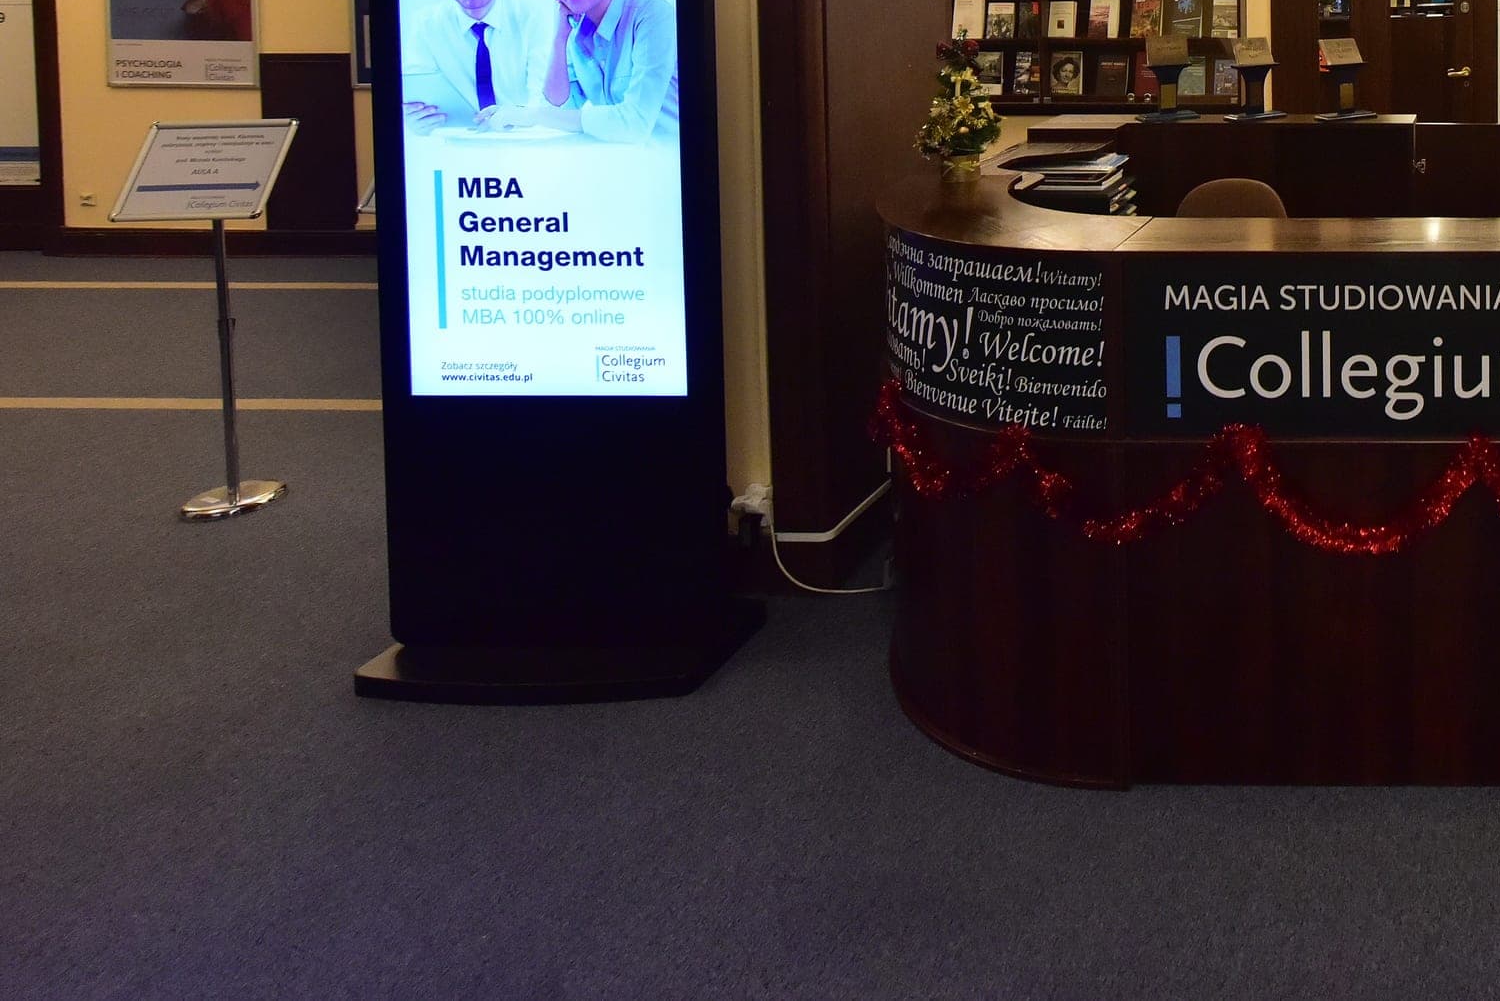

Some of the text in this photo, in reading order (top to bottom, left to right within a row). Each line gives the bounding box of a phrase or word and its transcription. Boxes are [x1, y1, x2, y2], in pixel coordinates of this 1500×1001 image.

[115, 59, 183, 69] PSYCHOLOGIA
[121, 70, 172, 79] COACHING
[457, 177, 524, 199] MBA
[458, 211, 569, 233] General
[460, 245, 645, 271] Management
[1041, 270, 1102, 291] Witamy!
[461, 285, 646, 305] studia podyplomowe
[1030, 295, 1104, 314] просимо!
[1164, 284, 1271, 311] MAGIA
[462, 308, 626, 325] MBA 100% online
[977, 309, 1102, 332] Добро пожаловать!
[979, 330, 1105, 367] Welcome!
[441, 361, 518, 372] Zobacz szczegóły
[601, 353, 666, 370] Collegium
[441, 372, 533, 383] www.civitas.edu.pl
[602, 370, 645, 382] Civitas
[946, 358, 1107, 399] Sveiki! Bienvenido
[904, 368, 977, 414] Bienvenue
[1062, 414, 1108, 430] Fáilte!
